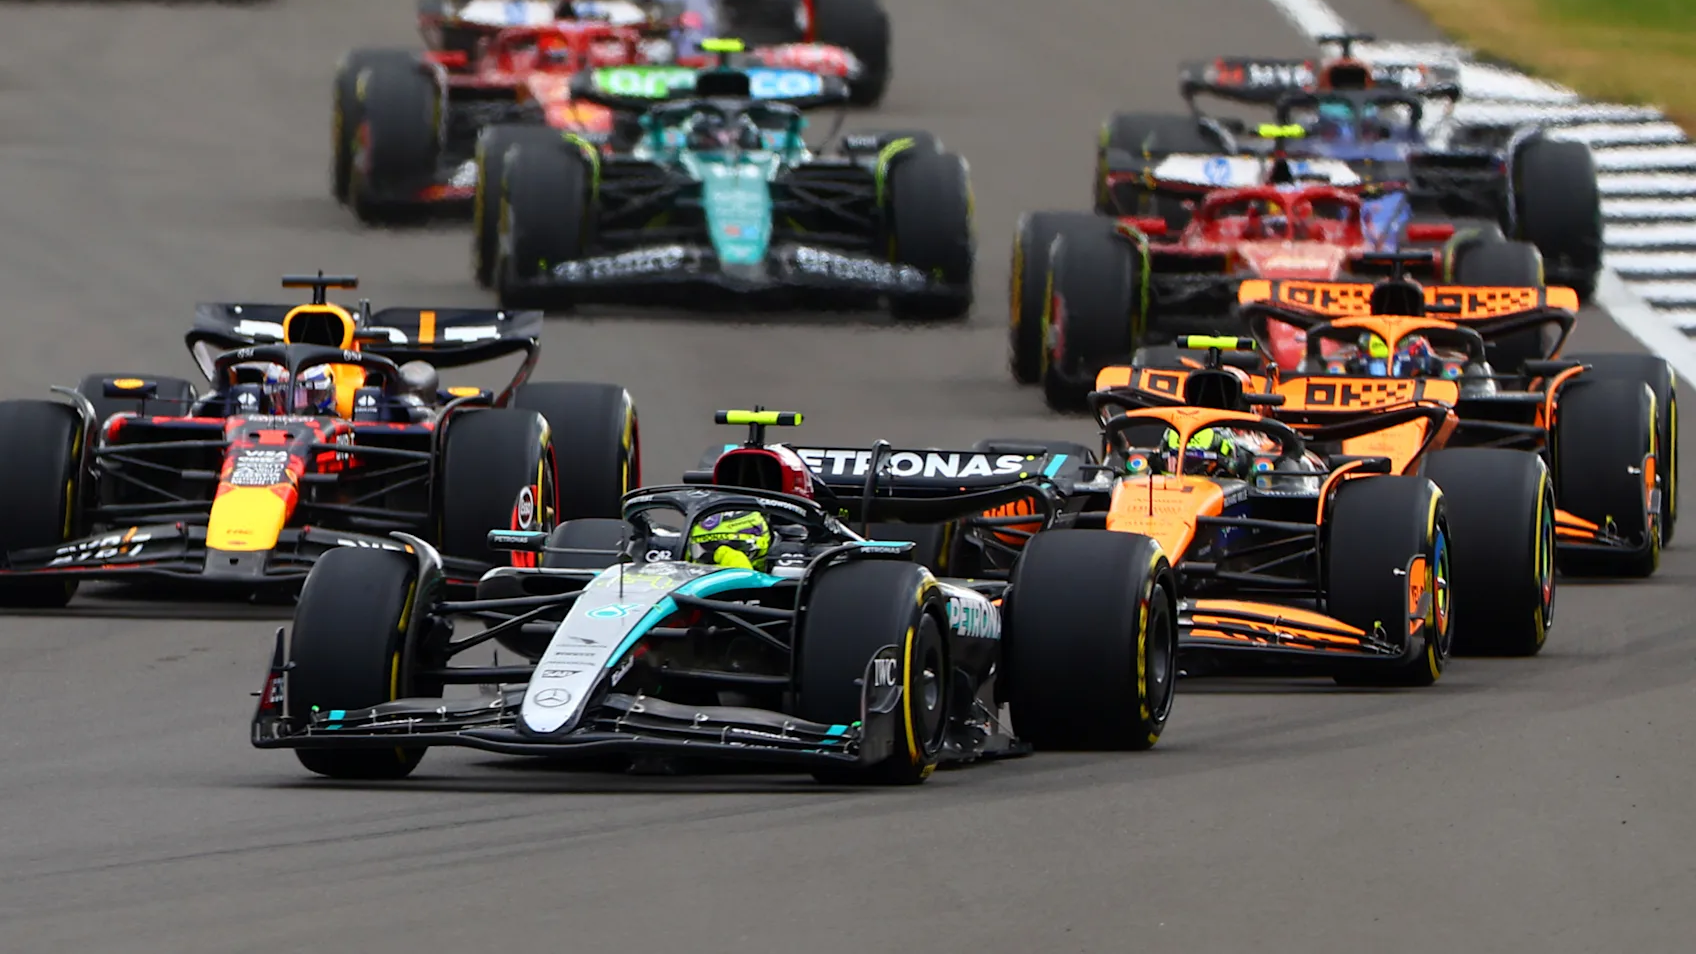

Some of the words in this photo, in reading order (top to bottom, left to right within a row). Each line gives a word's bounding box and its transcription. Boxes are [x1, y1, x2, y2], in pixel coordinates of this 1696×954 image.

[797, 449, 1023, 478] ETRONAS
[949, 597, 1002, 640] PETRONA
[874, 659, 897, 687] IWC
